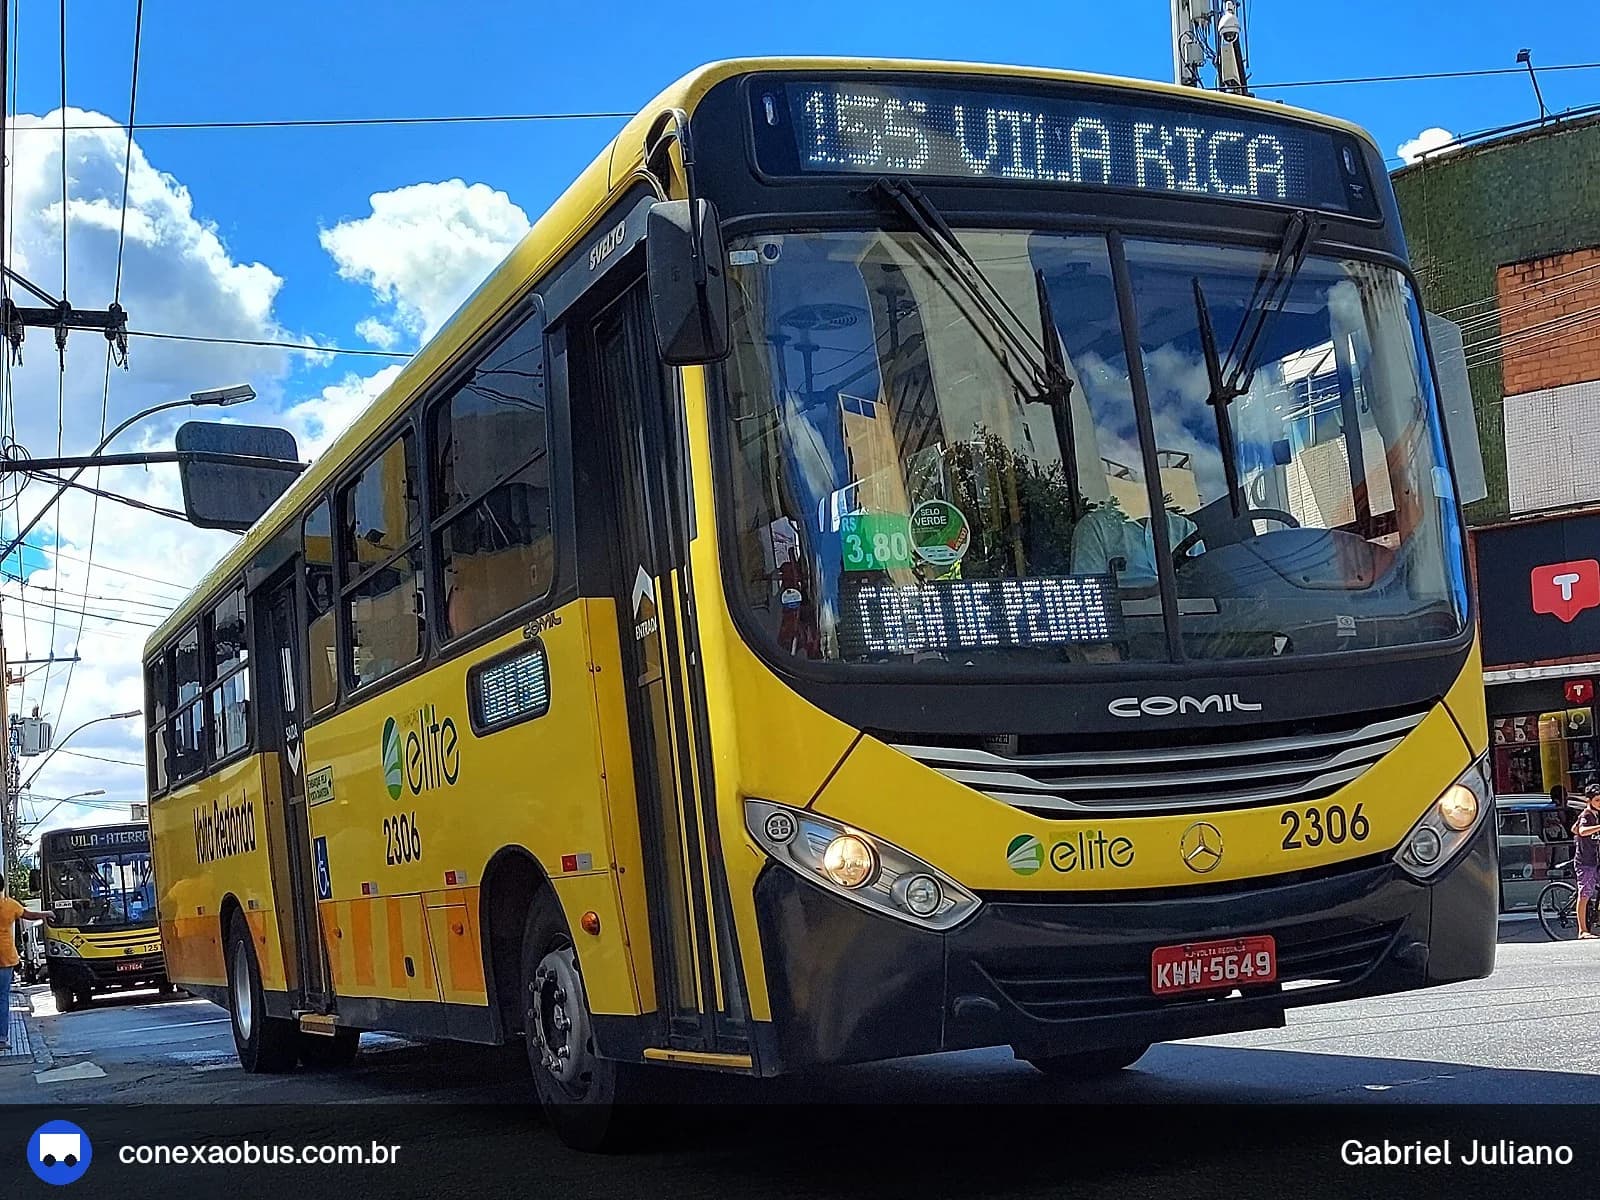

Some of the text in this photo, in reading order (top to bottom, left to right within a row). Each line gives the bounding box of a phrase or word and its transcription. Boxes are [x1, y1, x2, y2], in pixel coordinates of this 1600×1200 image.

[804, 90, 1288, 198] 155 VILA RICA
[589, 221, 626, 271] SVELTO
[841, 516, 857, 532] R$
[914, 515, 948, 527] VERDE
[920, 507, 940, 516] SELO
[846, 533, 908, 569] 3,80
[1552, 573, 1580, 601] T
[522, 612, 562, 639] COMIL
[858, 577, 1111, 651] CASA DE PEDRA
[1108, 693, 1262, 717] COMIL
[1573, 684, 1584, 696] T
[405, 703, 461, 797] elite
[213, 788, 257, 859] Redonda
[383, 811, 422, 866] 2306
[1280, 803, 1370, 851] 2306
[1049, 829, 1135, 873] elite
[144, 944, 162, 953] 125
